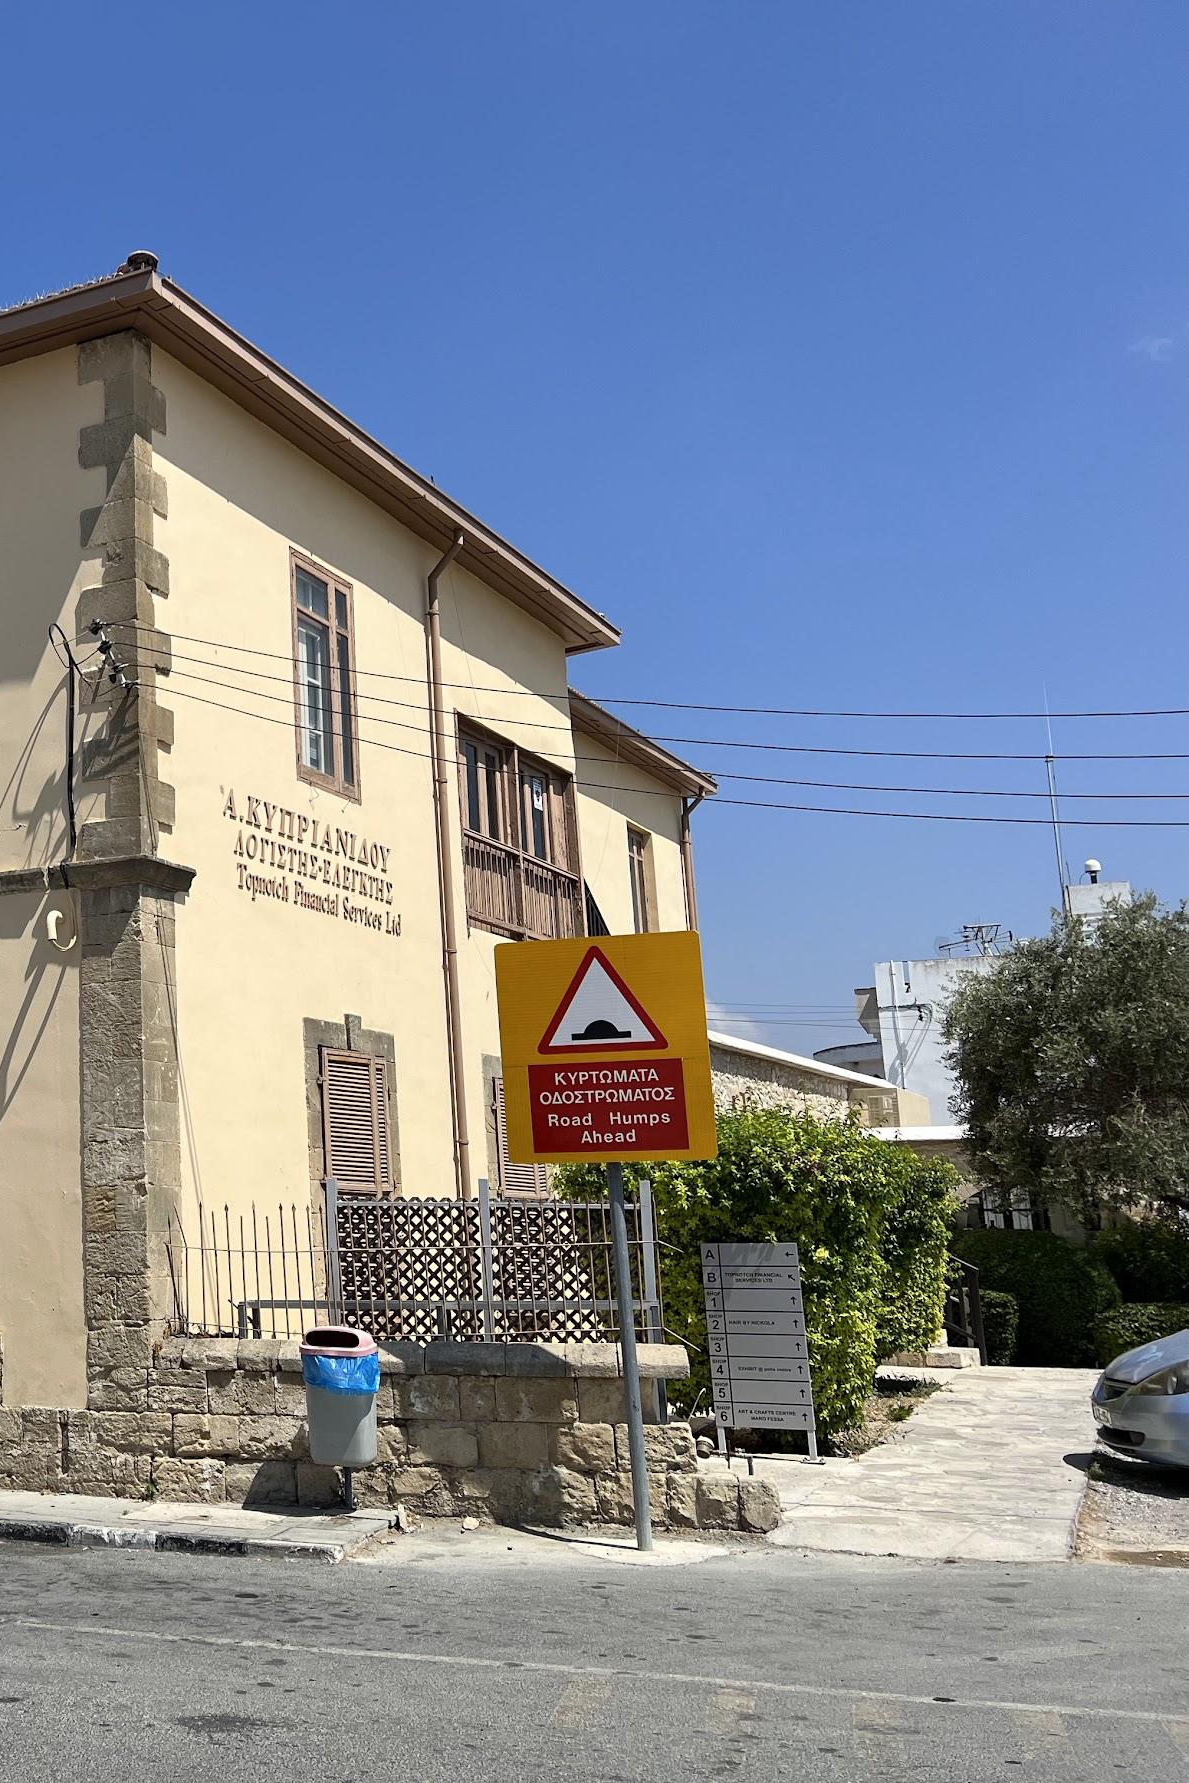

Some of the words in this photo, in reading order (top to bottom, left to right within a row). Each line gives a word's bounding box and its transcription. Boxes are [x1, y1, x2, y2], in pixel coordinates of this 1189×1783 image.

[236, 862, 289, 902] Topnotch
[293, 880, 340, 918] Financial
[342, 896, 383, 932] Services
[385, 911, 402, 938] Ltd
[554, 1068, 660, 1086] ΚΥΡΤΩΜΑΤΑ
[539, 1087, 676, 1106] ΟΔΟΣΤΡΩΜΑΤΟΣ
[547, 1113, 593, 1127] Road
[609, 1112, 671, 1127] Humps
[581, 1129, 637, 1144] Ahead
[705, 1249, 715, 1260] A
[707, 1272, 717, 1283] B
[711, 1297, 717, 1308] 1
[712, 1320, 720, 1330] 2
[714, 1342, 722, 1353] 3
[716, 1365, 724, 1375] 4
[718, 1388, 726, 1398] 5
[720, 1411, 728, 1422] 6
